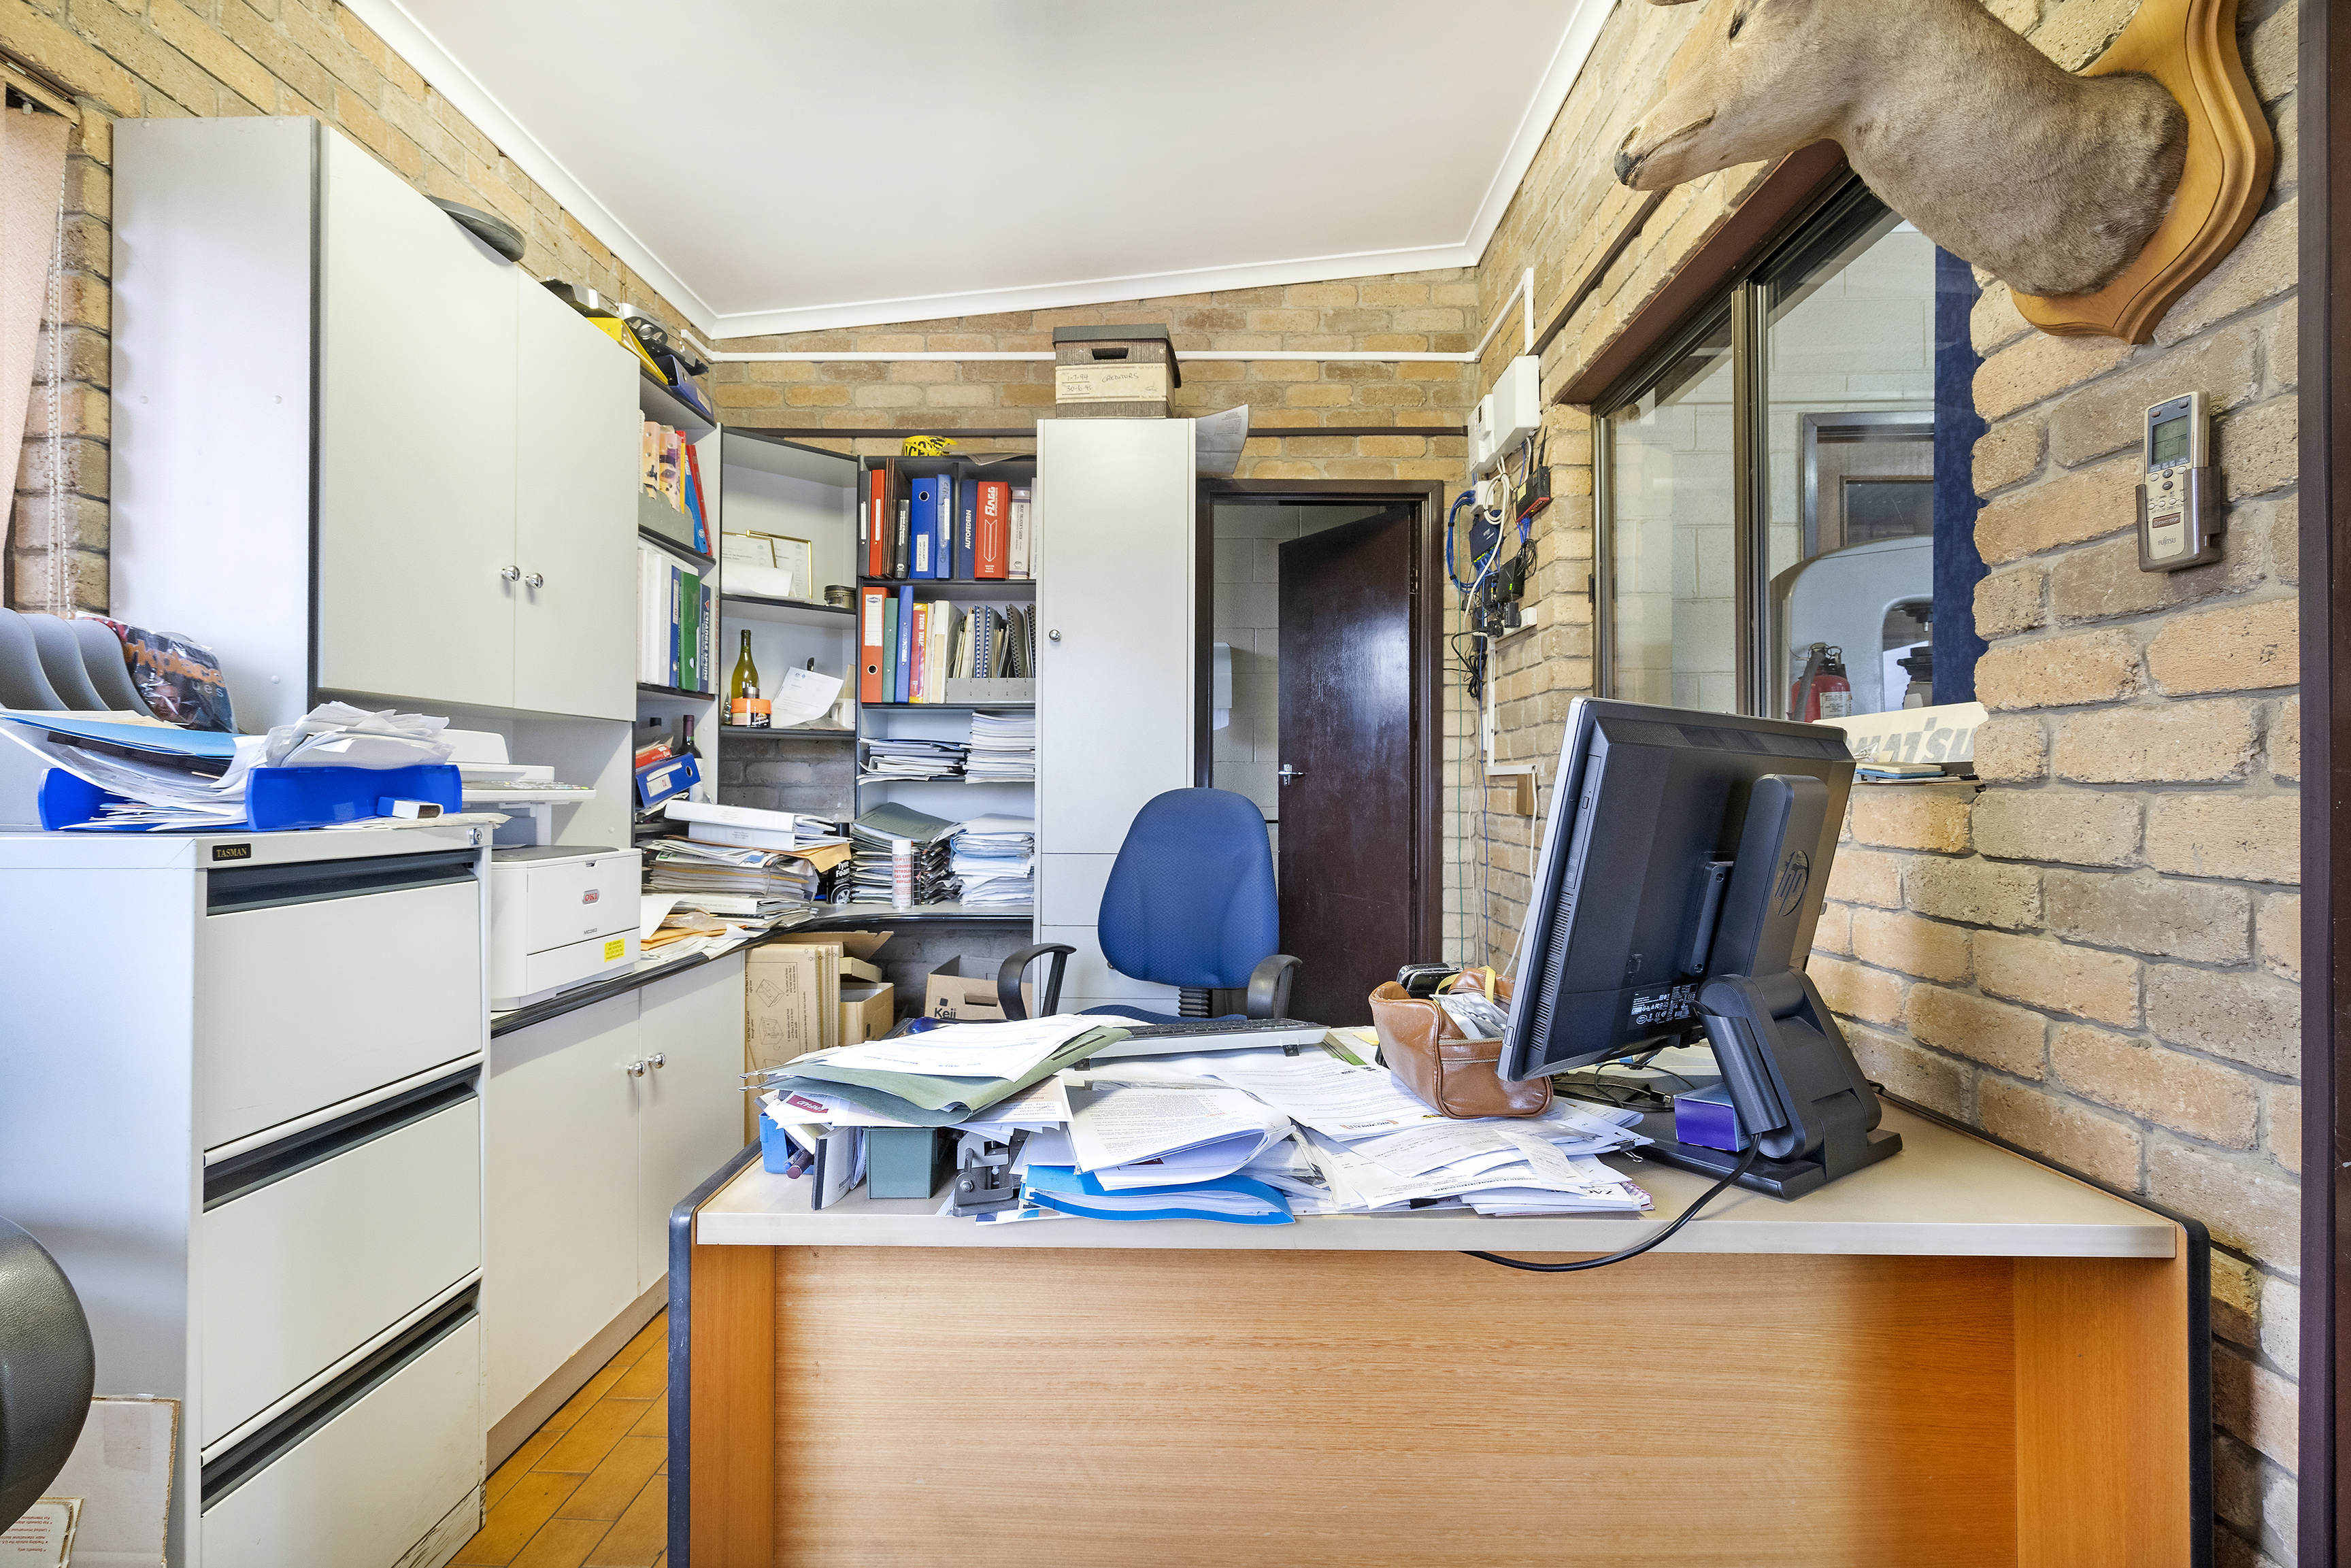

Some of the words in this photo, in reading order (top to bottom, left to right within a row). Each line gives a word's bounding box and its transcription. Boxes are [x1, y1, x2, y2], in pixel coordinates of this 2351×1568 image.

[1101, 373, 1139, 382] CREDITORS
[985, 486, 995, 516] FLAGG
[2158, 536, 2176, 546] FUJITSU
[216, 848, 247, 857] TASMAN
[838, 861, 849, 869] Tyre
[1774, 851, 1808, 916] hp
[585, 893, 597, 901] OKI
